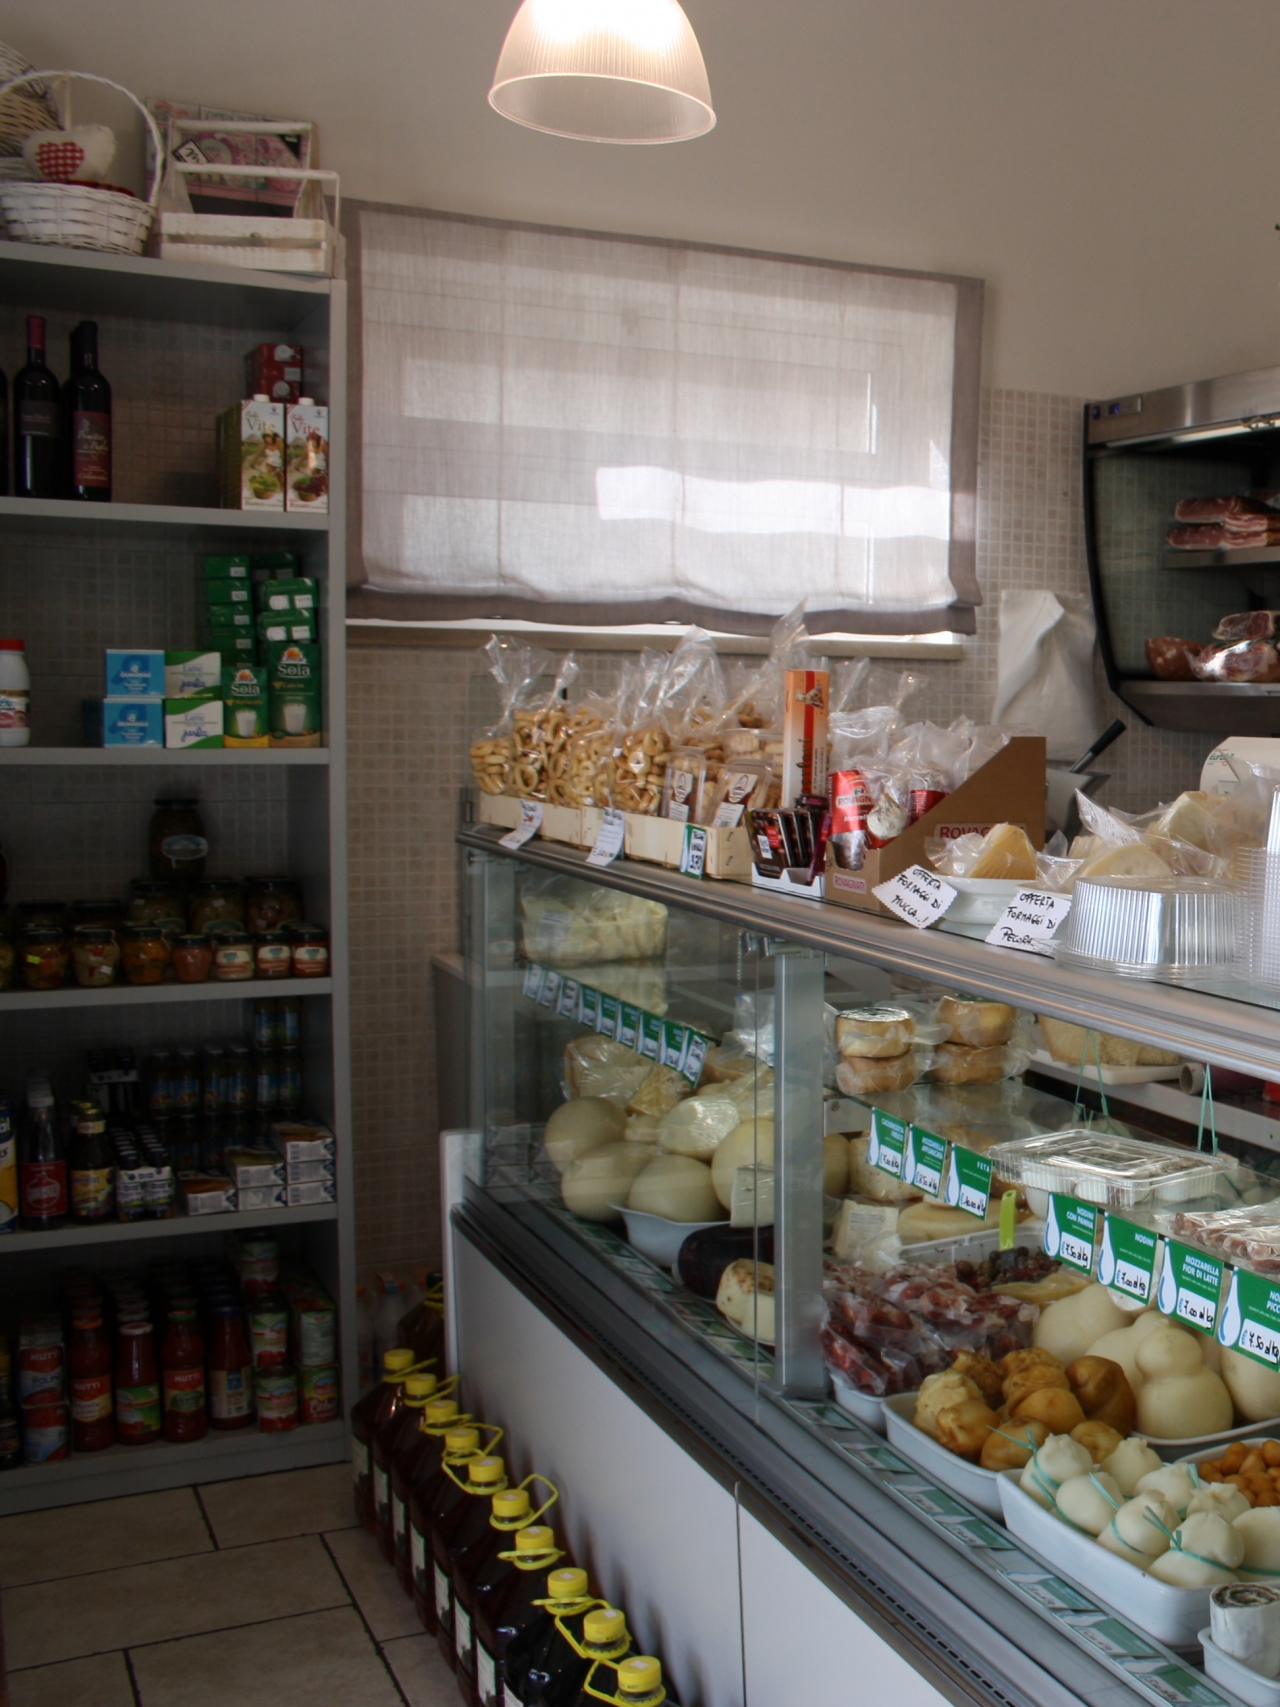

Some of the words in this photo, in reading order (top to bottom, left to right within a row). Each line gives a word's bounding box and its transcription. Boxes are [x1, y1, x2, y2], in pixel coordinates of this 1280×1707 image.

[291, 421, 321, 435] Vite
[277, 664, 310, 676] Soia
[231, 684, 260, 695] Soia
[838, 796, 872, 806] ROVAGN
[834, 875, 866, 892] ROVAGNATI
[912, 867, 942, 891] OFFERTA
[1019, 891, 1056, 910] OFFERTA
[977, 1161, 990, 1173] FETA
[1066, 1211, 1077, 1222] CON
[1077, 1215, 1094, 1230] PANNA
[1076, 1206, 1095, 1220] NODINI
[1134, 1232, 1154, 1248] NODINI
[1184, 1254, 1219, 1276] MOZZARELLA
[1182, 1263, 1196, 1276] FIOR
[1196, 1268, 1203, 1278] DI
[1203, 1272, 1219, 1287] LATTE
[174, 1372, 201, 1383] MUTTI
